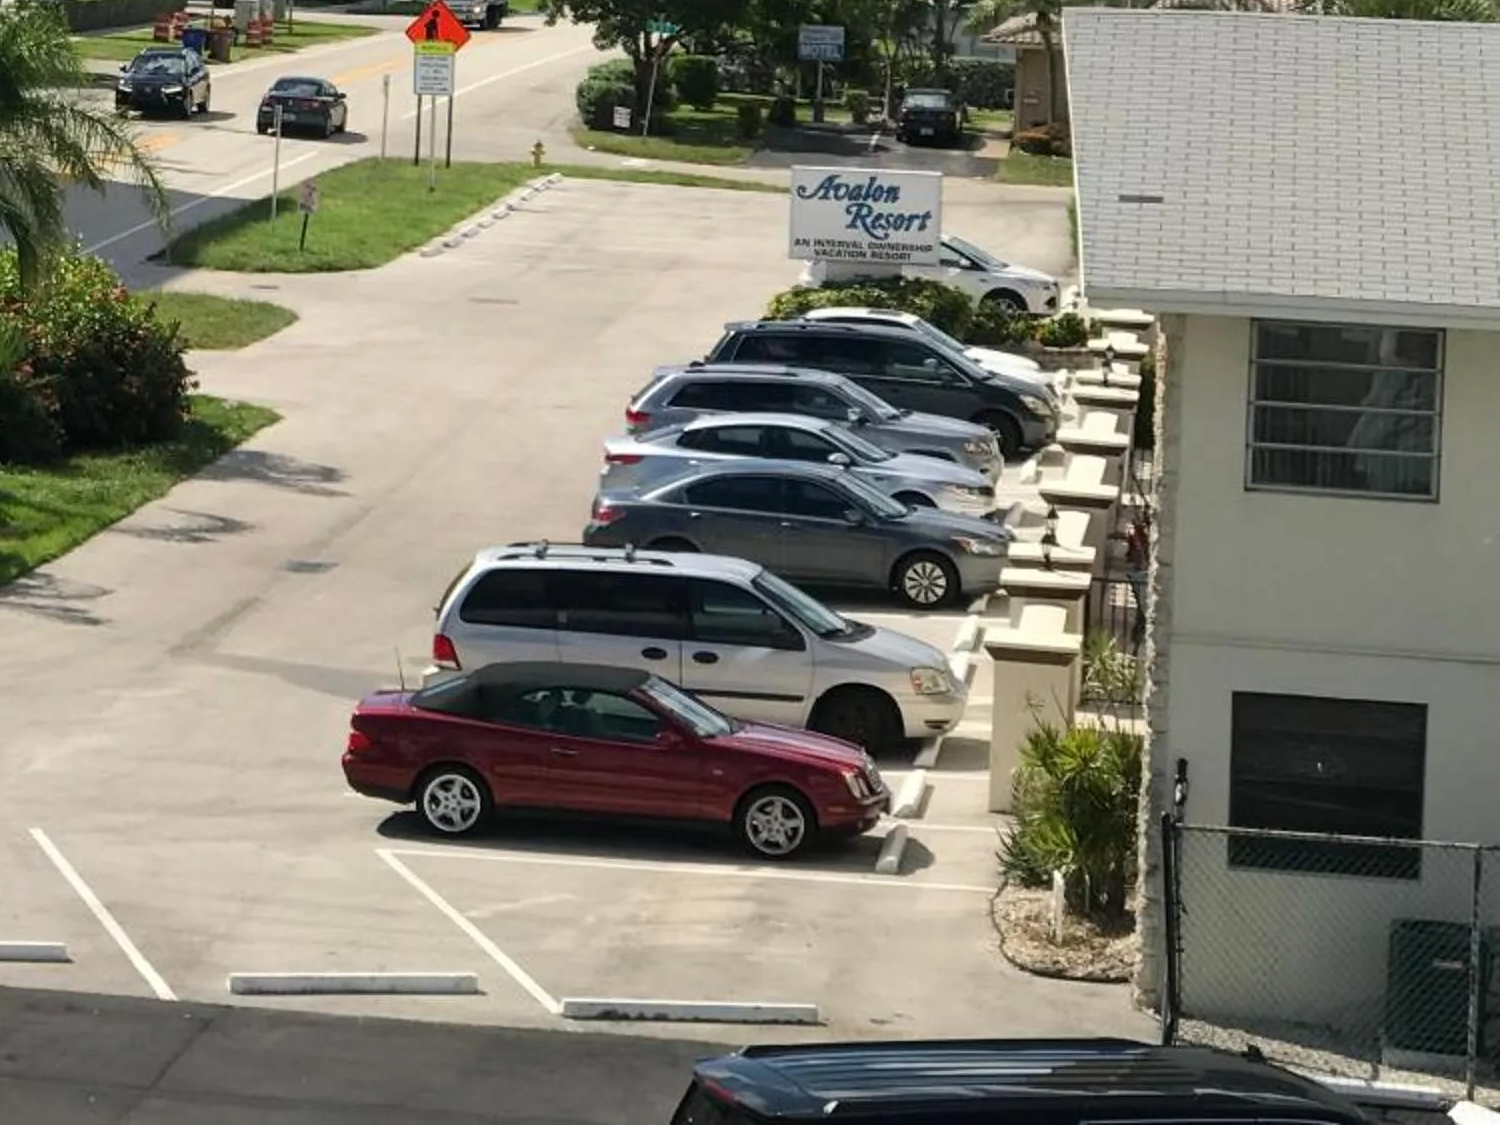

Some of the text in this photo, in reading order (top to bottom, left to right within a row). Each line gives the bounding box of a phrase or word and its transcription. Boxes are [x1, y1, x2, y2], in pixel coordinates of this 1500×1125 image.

[796, 174, 901, 203] Avalon
[845, 202, 933, 241] Resort
[794, 238, 933, 252] AN INTERVAL OWNERSHIP
[814, 249, 912, 261] VACATION RESORT
